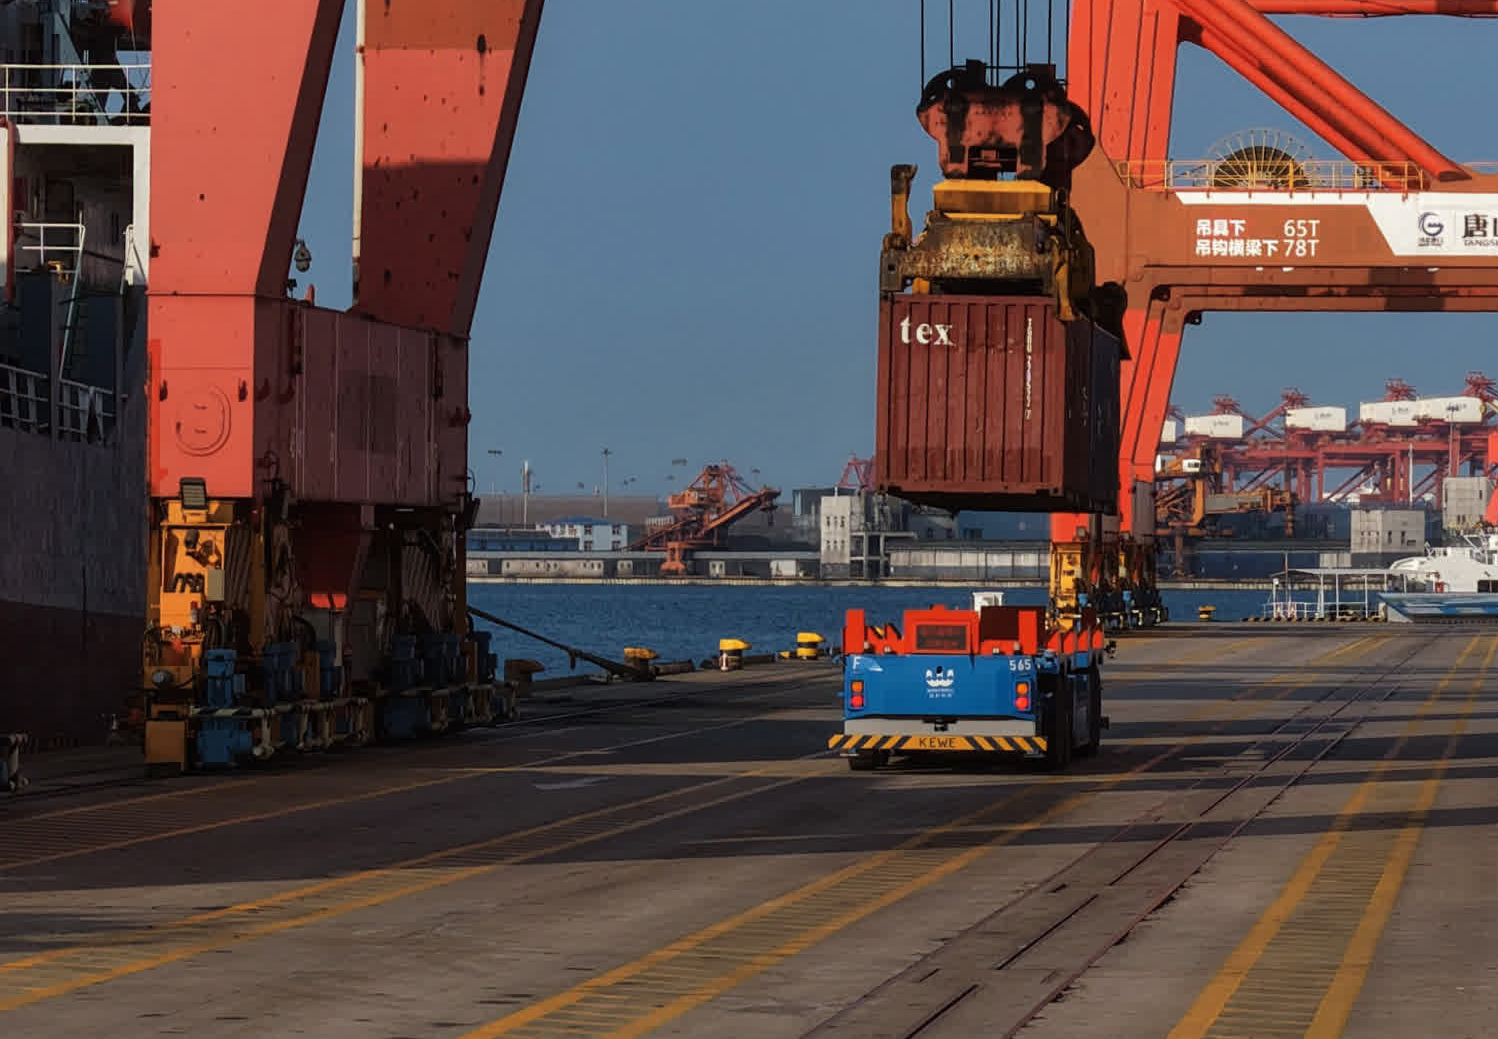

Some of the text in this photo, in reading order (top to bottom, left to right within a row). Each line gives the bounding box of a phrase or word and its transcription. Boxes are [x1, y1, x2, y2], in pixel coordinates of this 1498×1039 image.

[1284, 220, 1320, 237] 65T
[1284, 239, 1319, 256] 78T
[900, 316, 953, 346] tex
[1008, 658, 1032, 671] 565
[919, 737, 957, 748] KEWE
